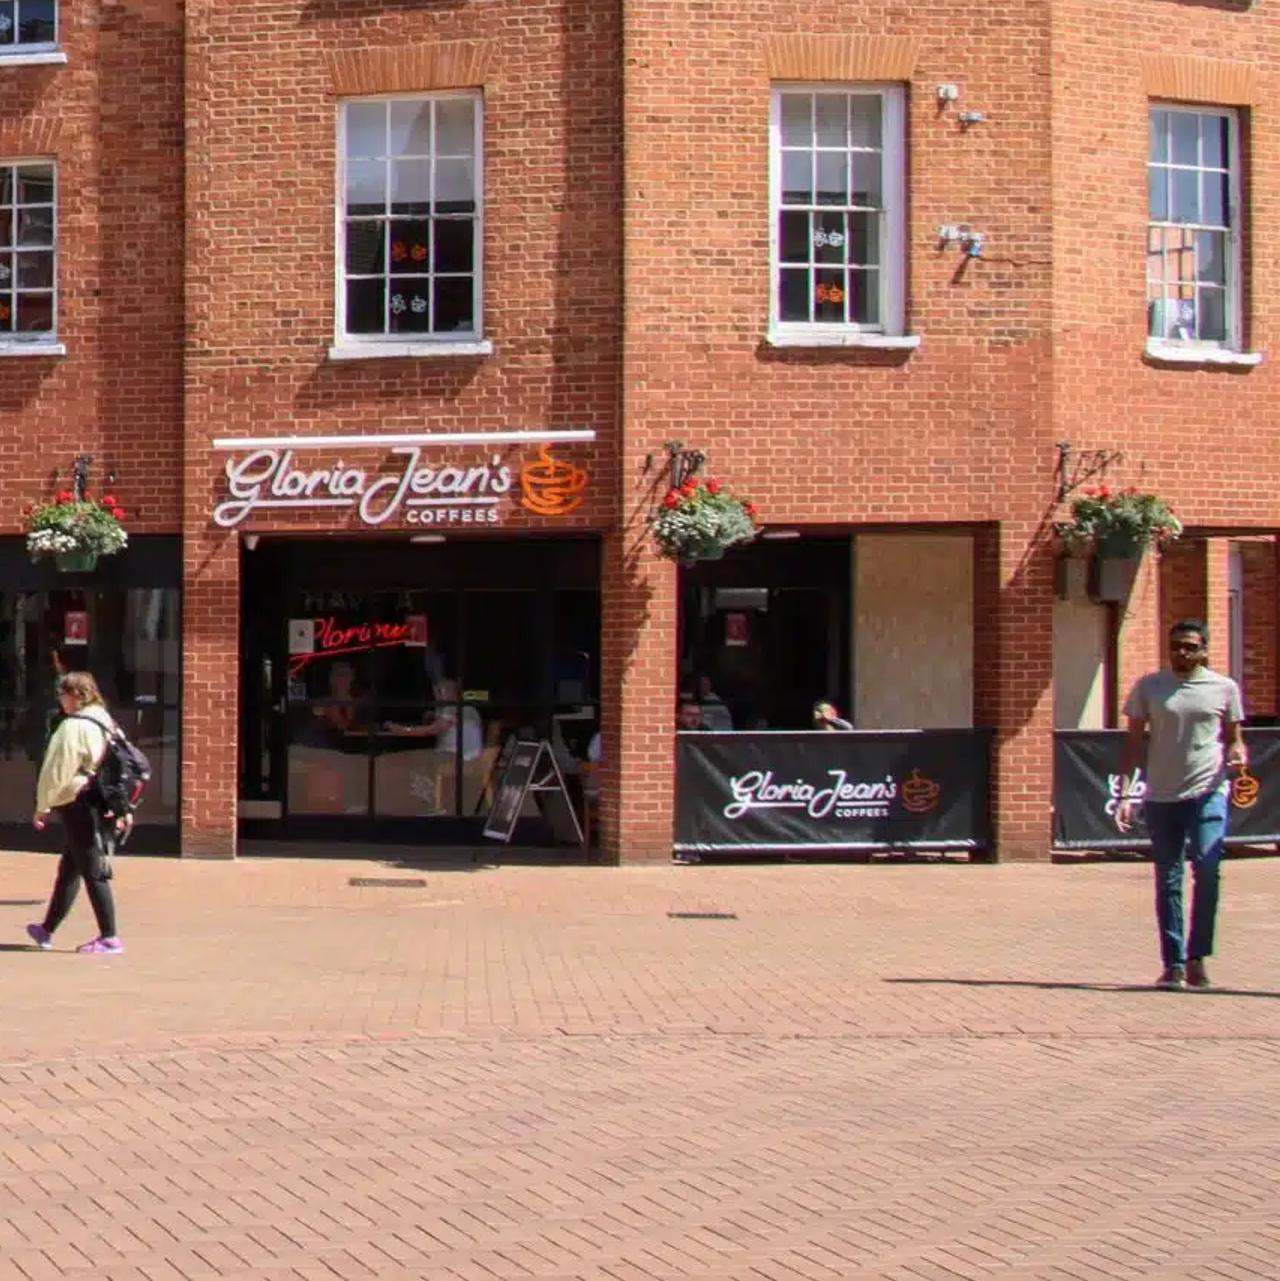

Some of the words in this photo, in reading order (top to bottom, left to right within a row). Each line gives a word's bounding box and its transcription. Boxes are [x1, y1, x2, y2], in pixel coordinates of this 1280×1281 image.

[213, 449, 366, 527] Gloria
[358, 446, 512, 525] Jean's
[406, 508, 499, 524] COFFEES
[724, 771, 815, 819] Gloria
[808, 770, 898, 818] Jean's
[835, 808, 889, 818] COFFEES
